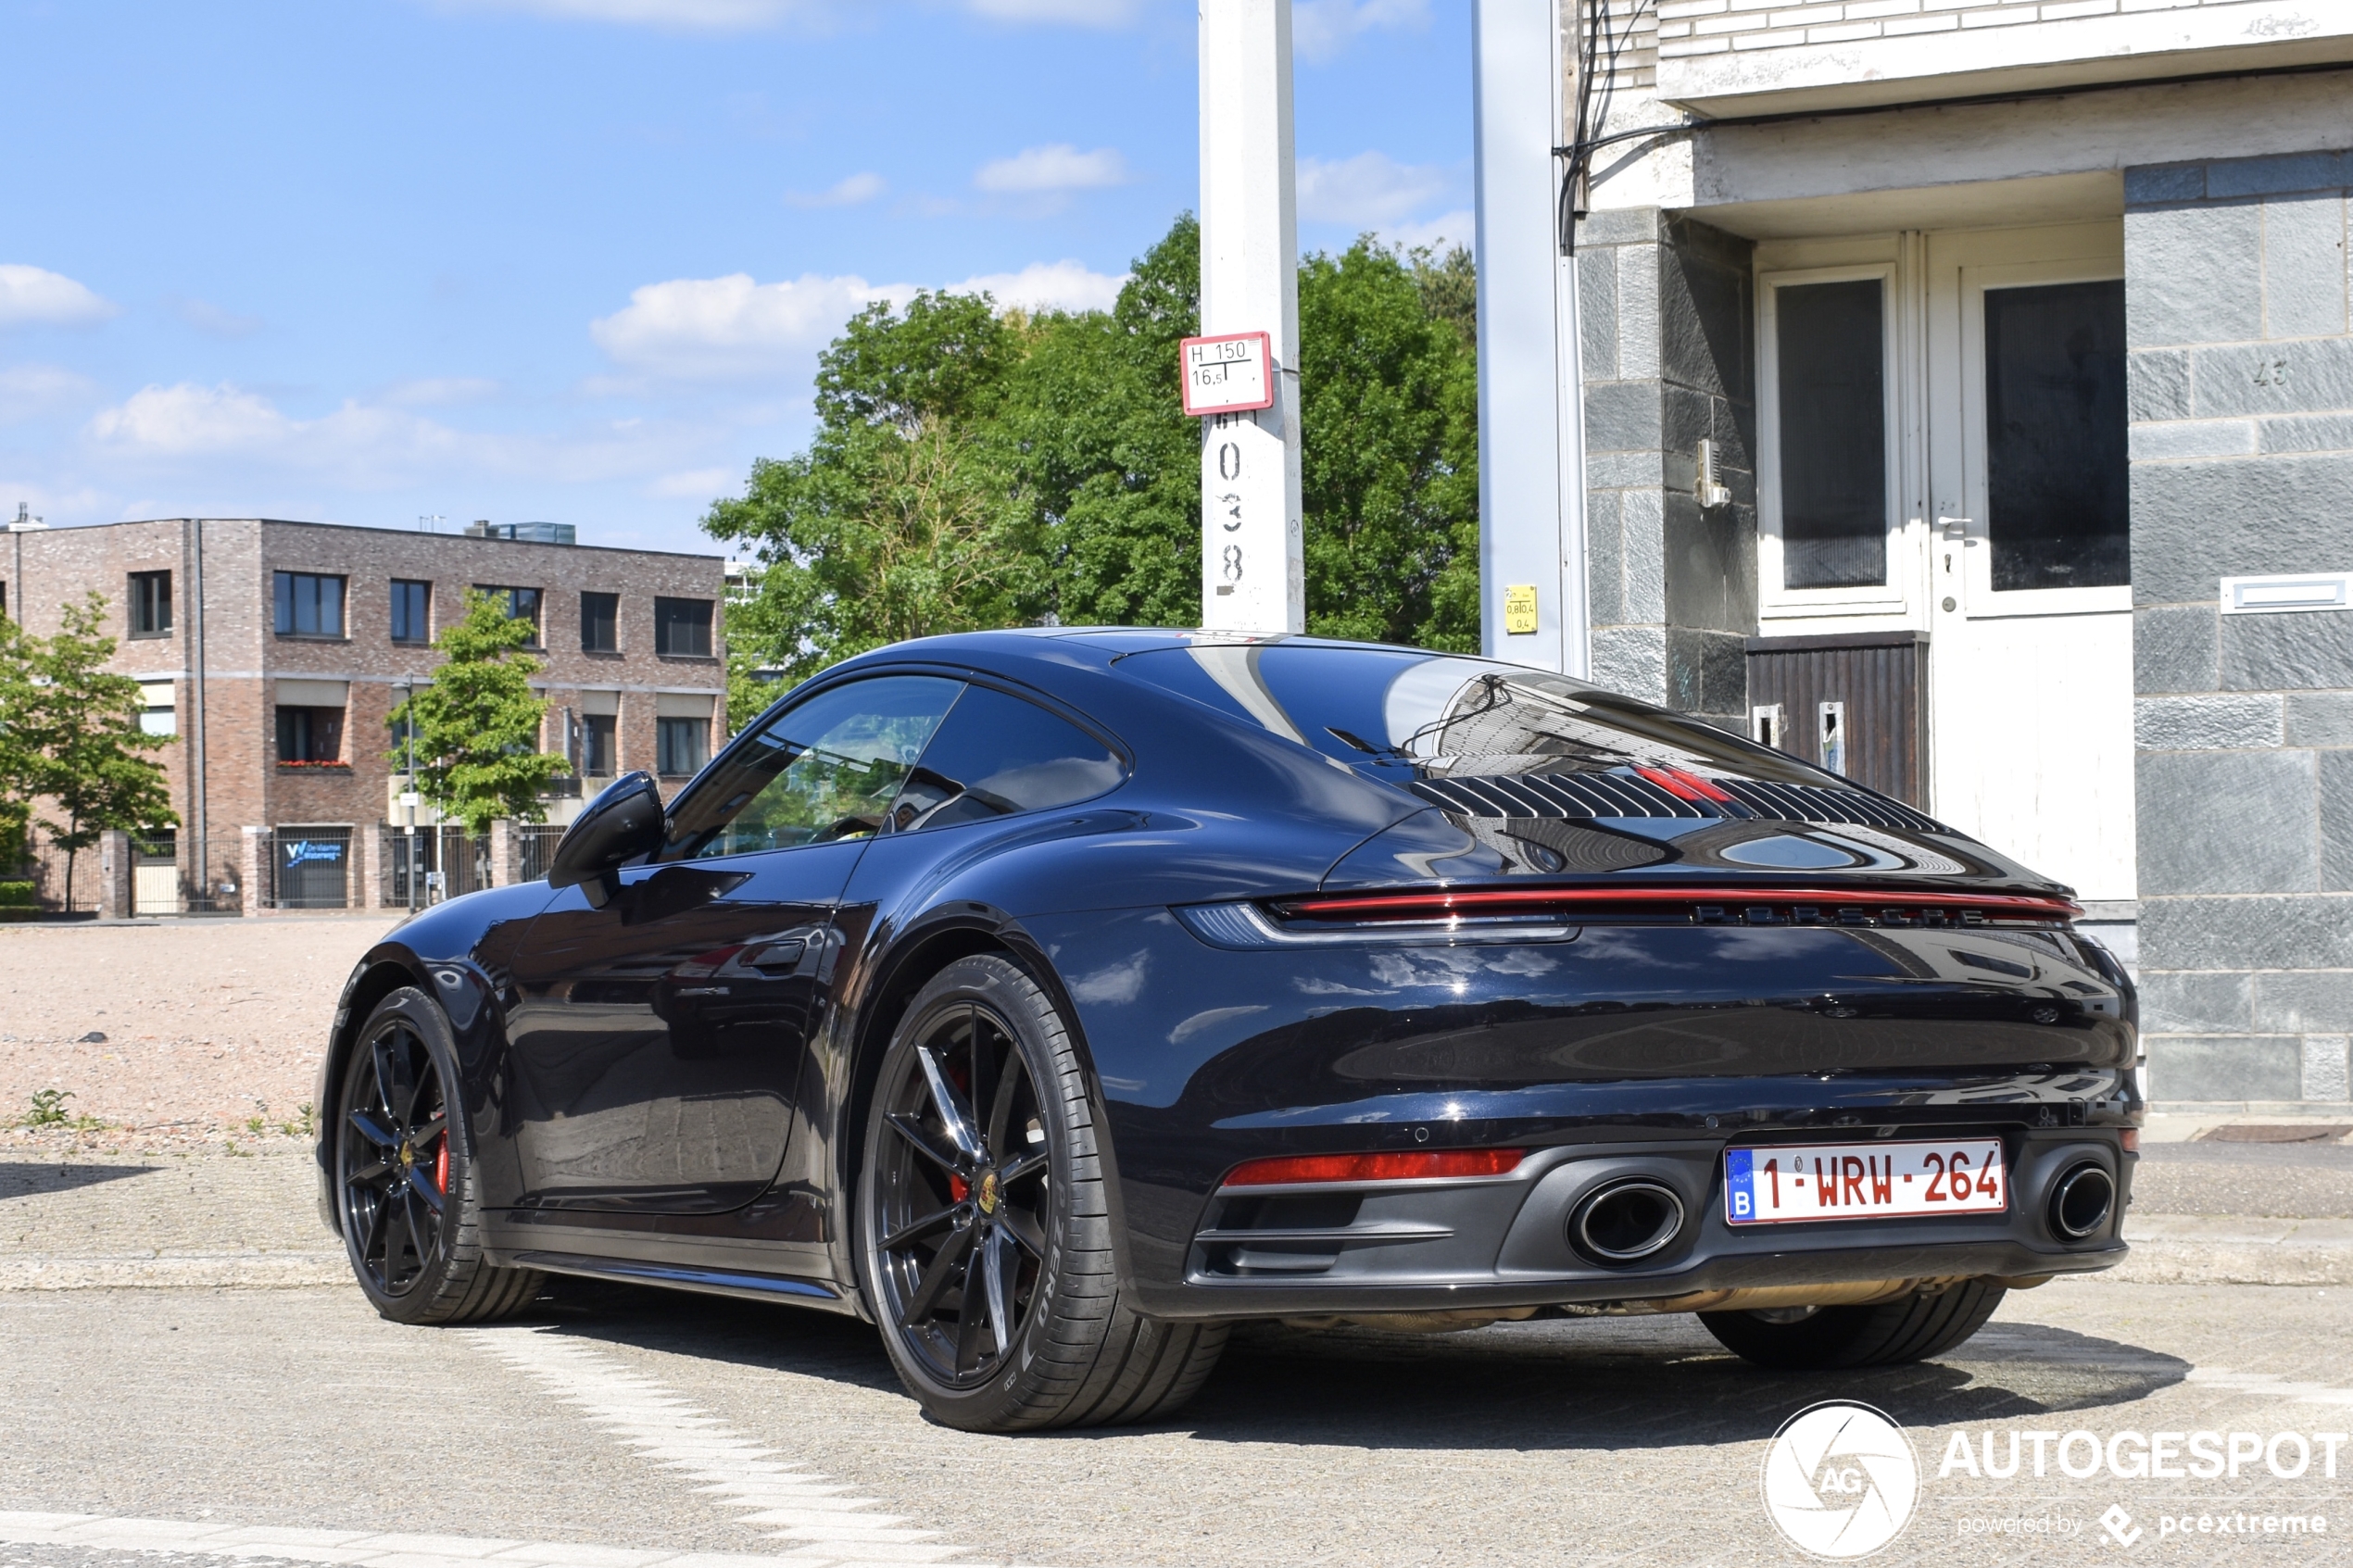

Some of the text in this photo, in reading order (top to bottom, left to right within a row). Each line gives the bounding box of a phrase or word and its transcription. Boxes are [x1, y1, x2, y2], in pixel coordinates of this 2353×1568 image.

[1191, 346, 1202, 362] H
[1215, 342, 1246, 359] 150
[1192, 370, 1223, 386] 16,5
[2253, 360, 2287, 386] 43
[1506, 604, 1534, 615] 0,8 0,4
[1516, 620, 1529, 630] 0,4
[1694, 906, 1983, 925] PORSCHE
[1764, 1150, 1997, 1209] 1-WRW-264
[1734, 1191, 1751, 1215] B
[1037, 1215, 1064, 1328] ZERO
